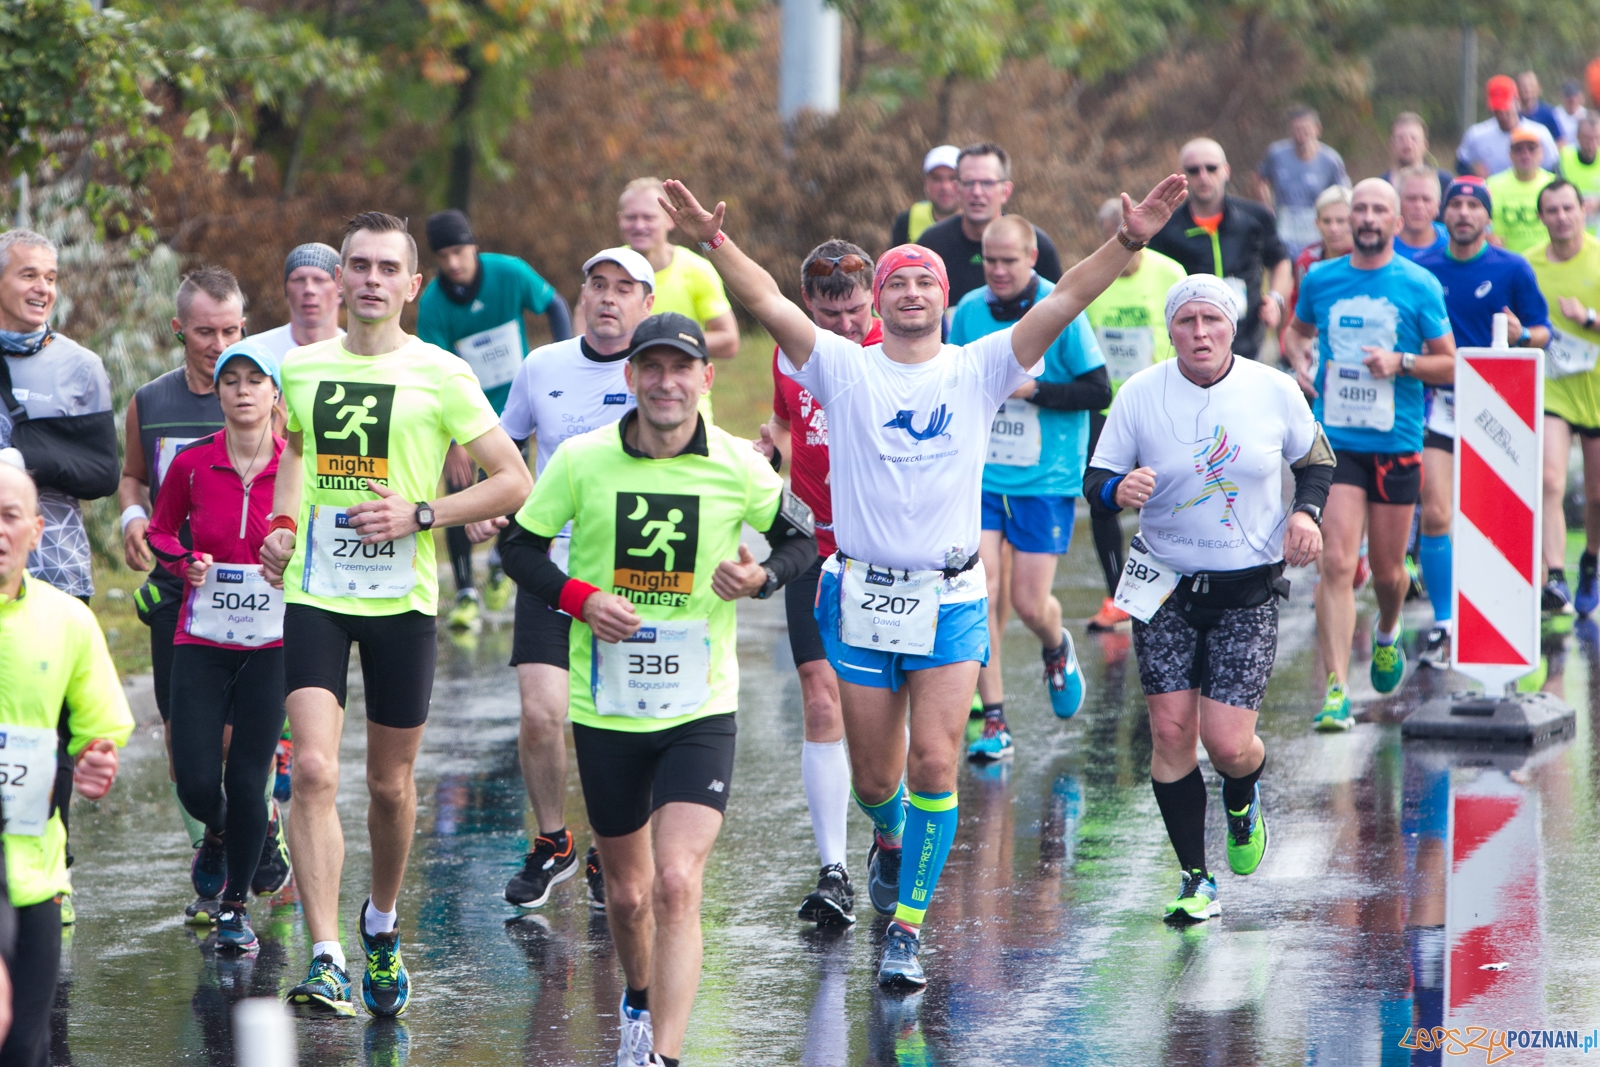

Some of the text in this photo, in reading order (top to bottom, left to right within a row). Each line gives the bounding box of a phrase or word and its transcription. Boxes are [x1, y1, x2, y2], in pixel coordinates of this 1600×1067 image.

[1339, 386, 1377, 403] 4819
[329, 456, 375, 475] night
[879, 453, 922, 463] WRONIECKI
[333, 538, 396, 558] 2704
[1157, 530, 1246, 549] EUFORIA BIEGACZA
[334, 562, 392, 573] Przemysław
[629, 572, 679, 591] night
[211, 592, 270, 611] 5042
[613, 586, 690, 607] runners
[861, 592, 920, 615] 2207
[227, 614, 254, 624] Agata
[872, 616, 901, 627] Dawid
[629, 654, 679, 675] 336
[628, 679, 680, 691] Bogusław
